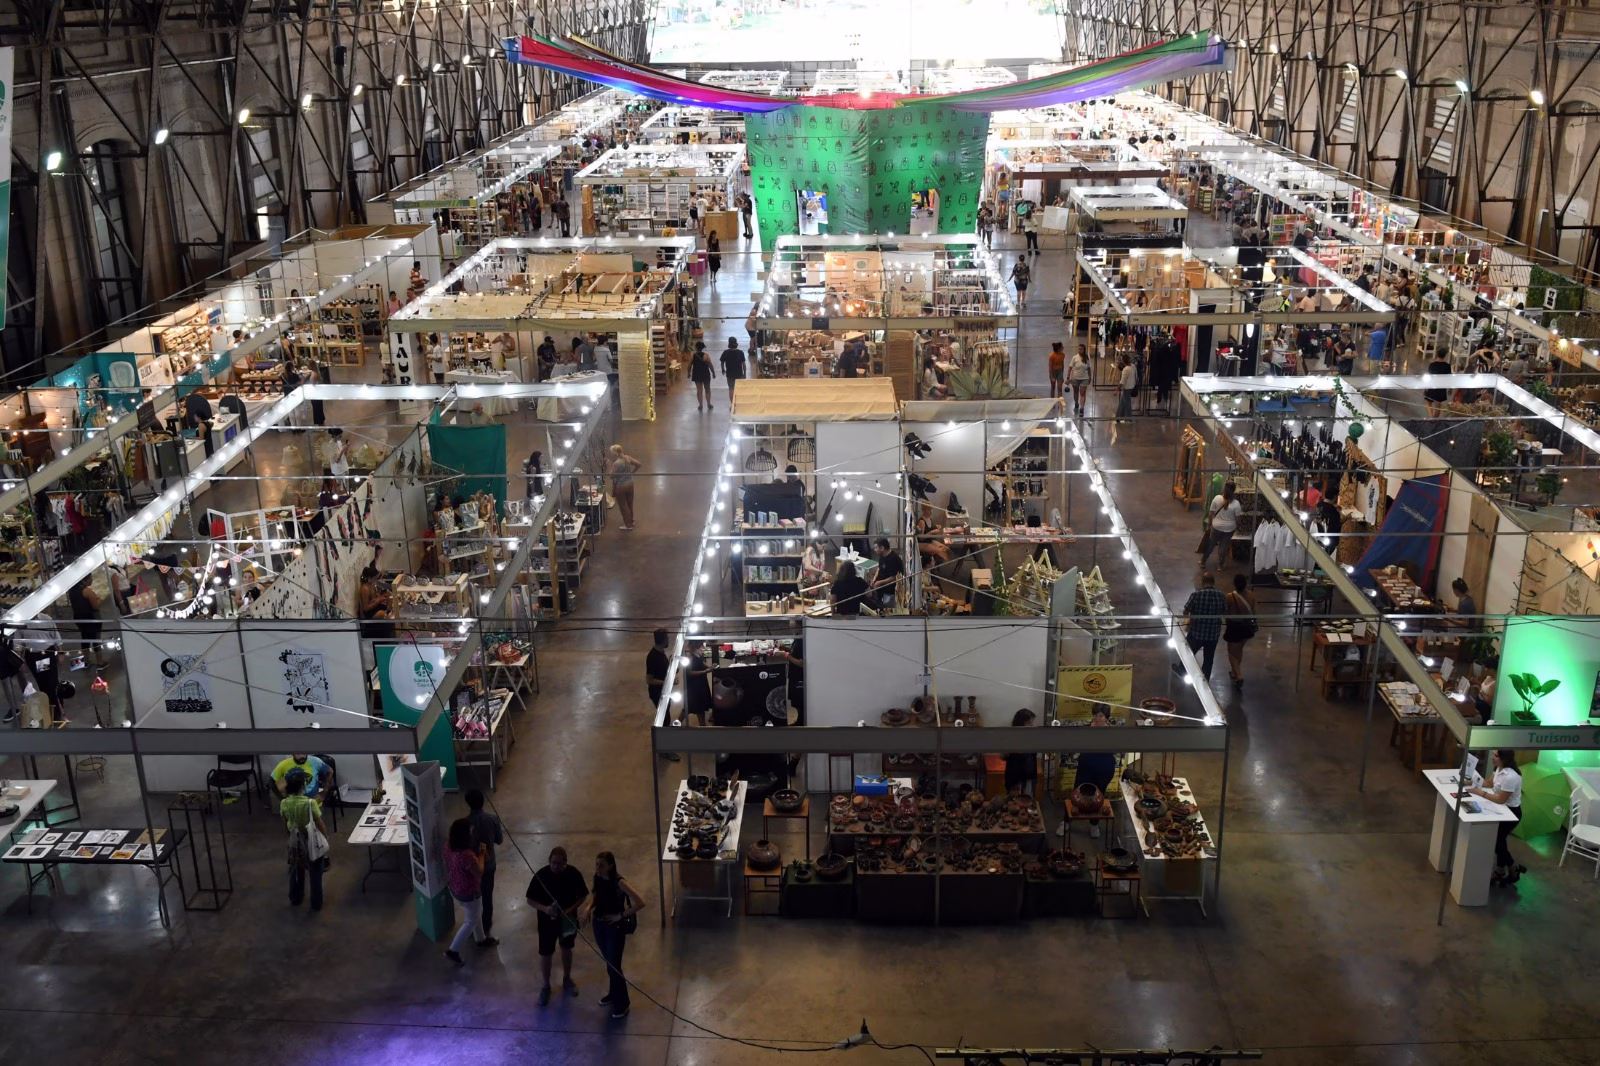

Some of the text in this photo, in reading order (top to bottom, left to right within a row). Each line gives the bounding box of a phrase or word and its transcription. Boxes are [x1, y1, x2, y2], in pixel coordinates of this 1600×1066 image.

[957, 321, 995, 332] PACHAS
[395, 332, 414, 402] TAUR
[1527, 732, 1580, 744] Turismo
